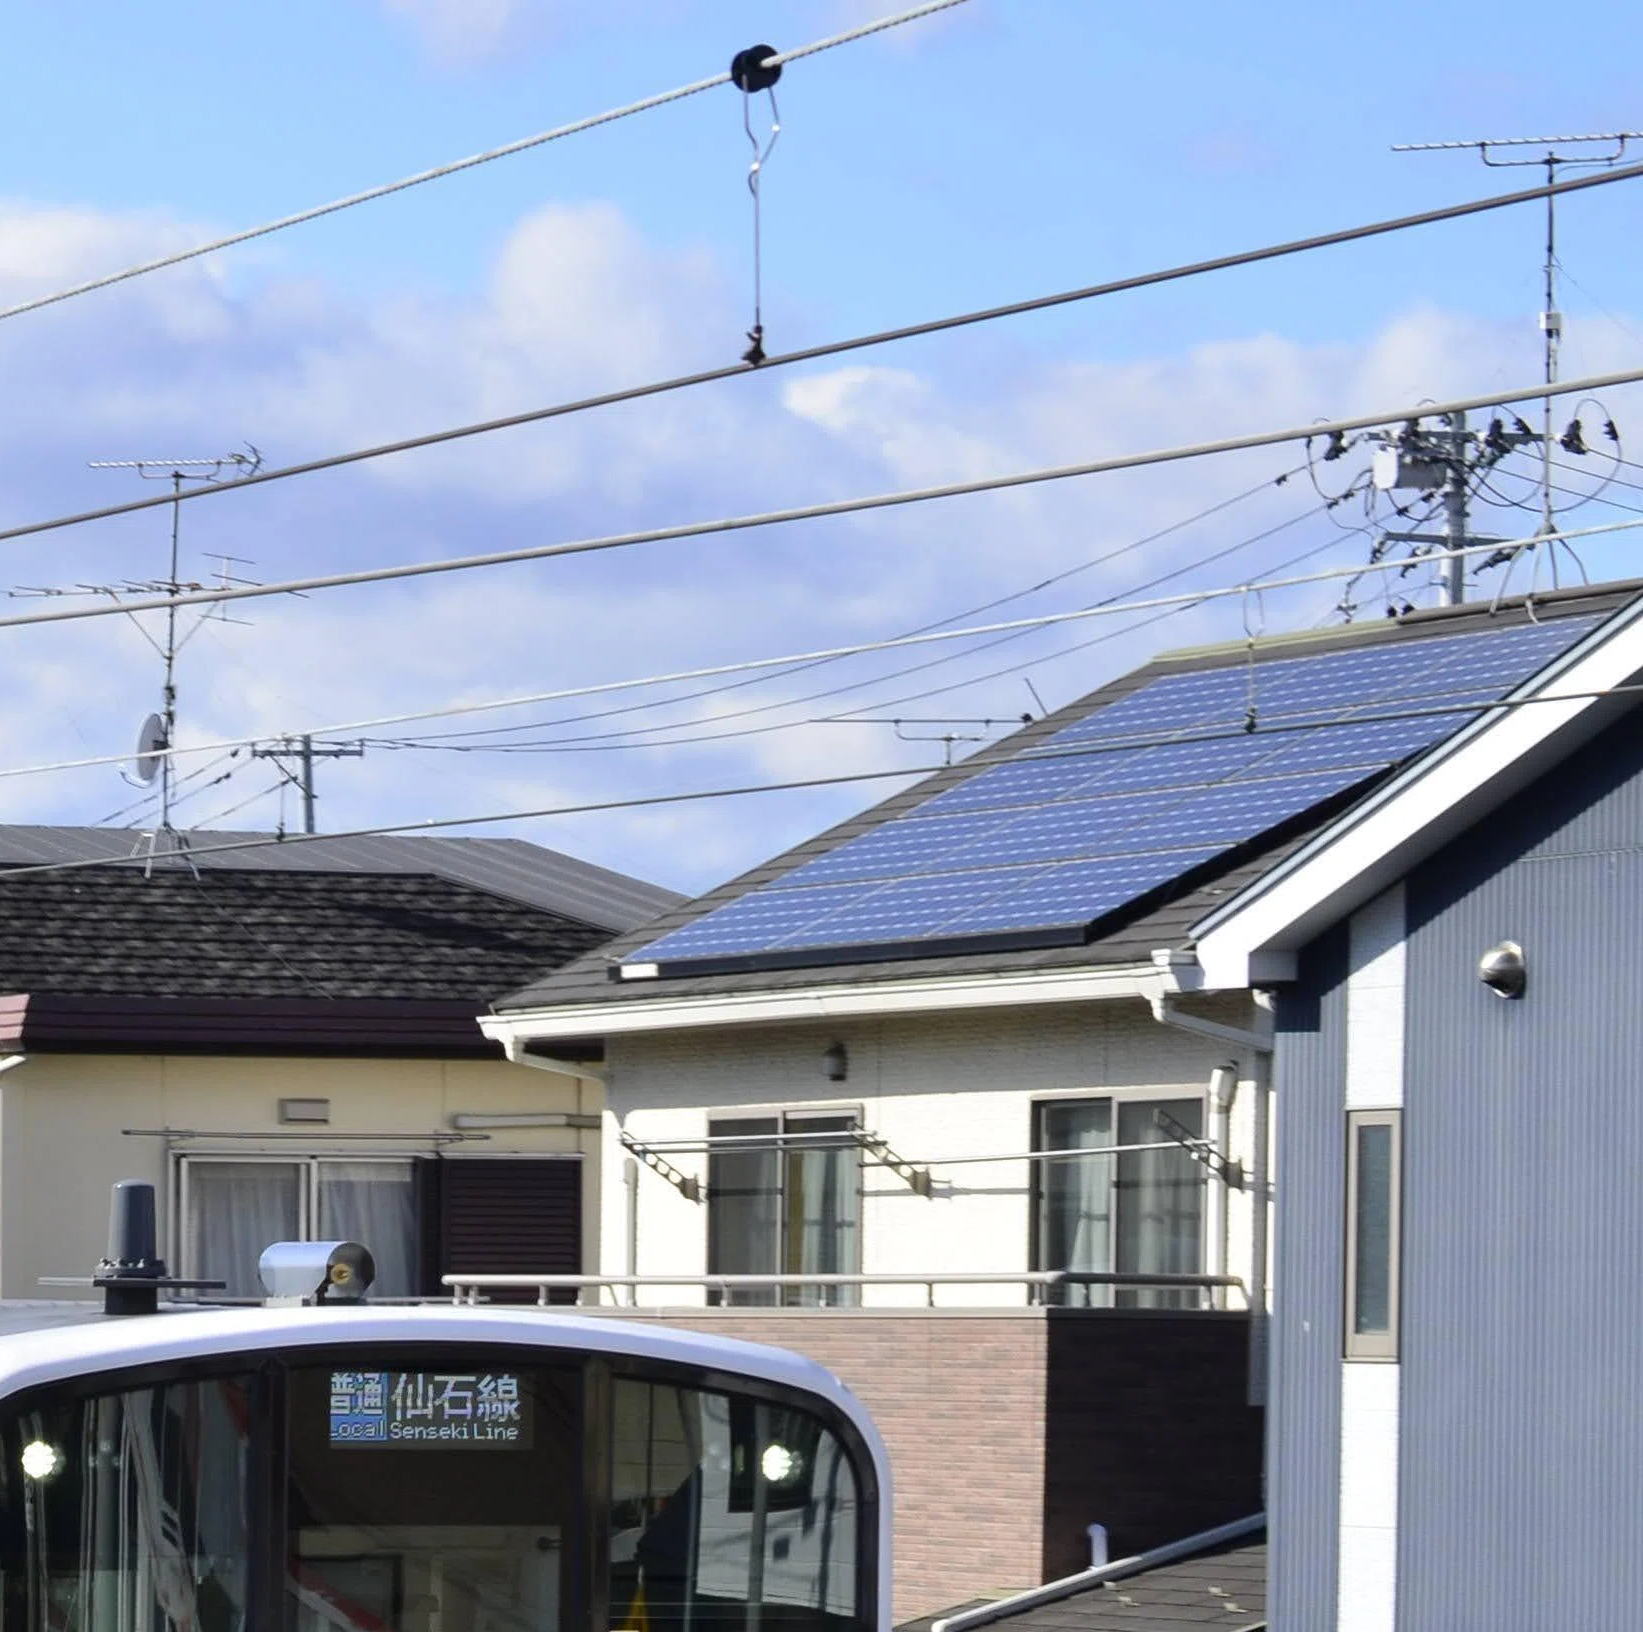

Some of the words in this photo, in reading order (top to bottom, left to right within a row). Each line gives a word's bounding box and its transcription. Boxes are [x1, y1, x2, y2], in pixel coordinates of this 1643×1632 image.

[330, 1372, 384, 1415] 普通
[391, 1372, 521, 1422] 仙石線
[330, 1421, 385, 1438] Local
[390, 1422, 469, 1440] Senseki
[473, 1422, 519, 1440] Line
